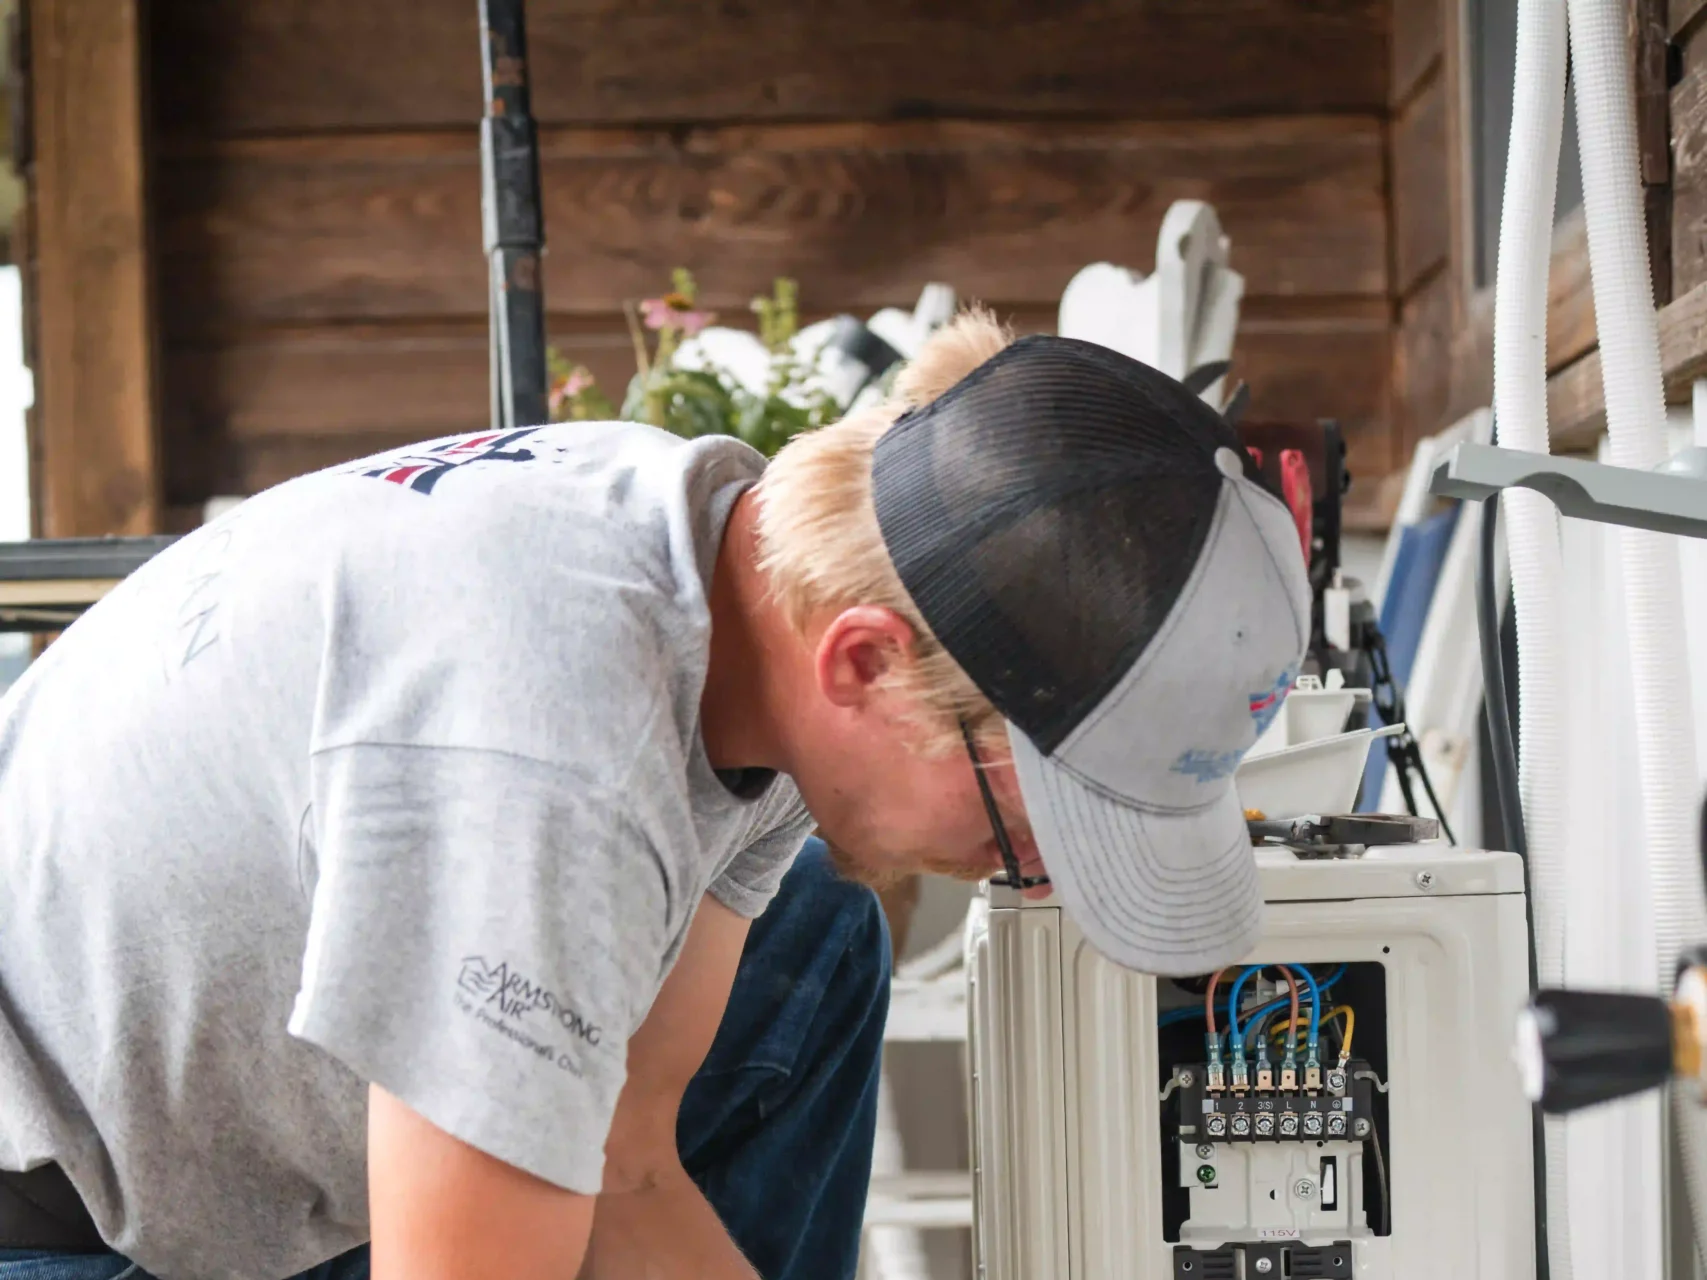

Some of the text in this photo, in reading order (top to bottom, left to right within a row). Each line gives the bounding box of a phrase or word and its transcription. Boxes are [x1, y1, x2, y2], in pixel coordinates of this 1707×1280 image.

[488, 962, 603, 1048] ARMSTONG
[1215, 1100, 1317, 1110] 1 2 3(S) L N
[1261, 1229, 1296, 1237] 115V
